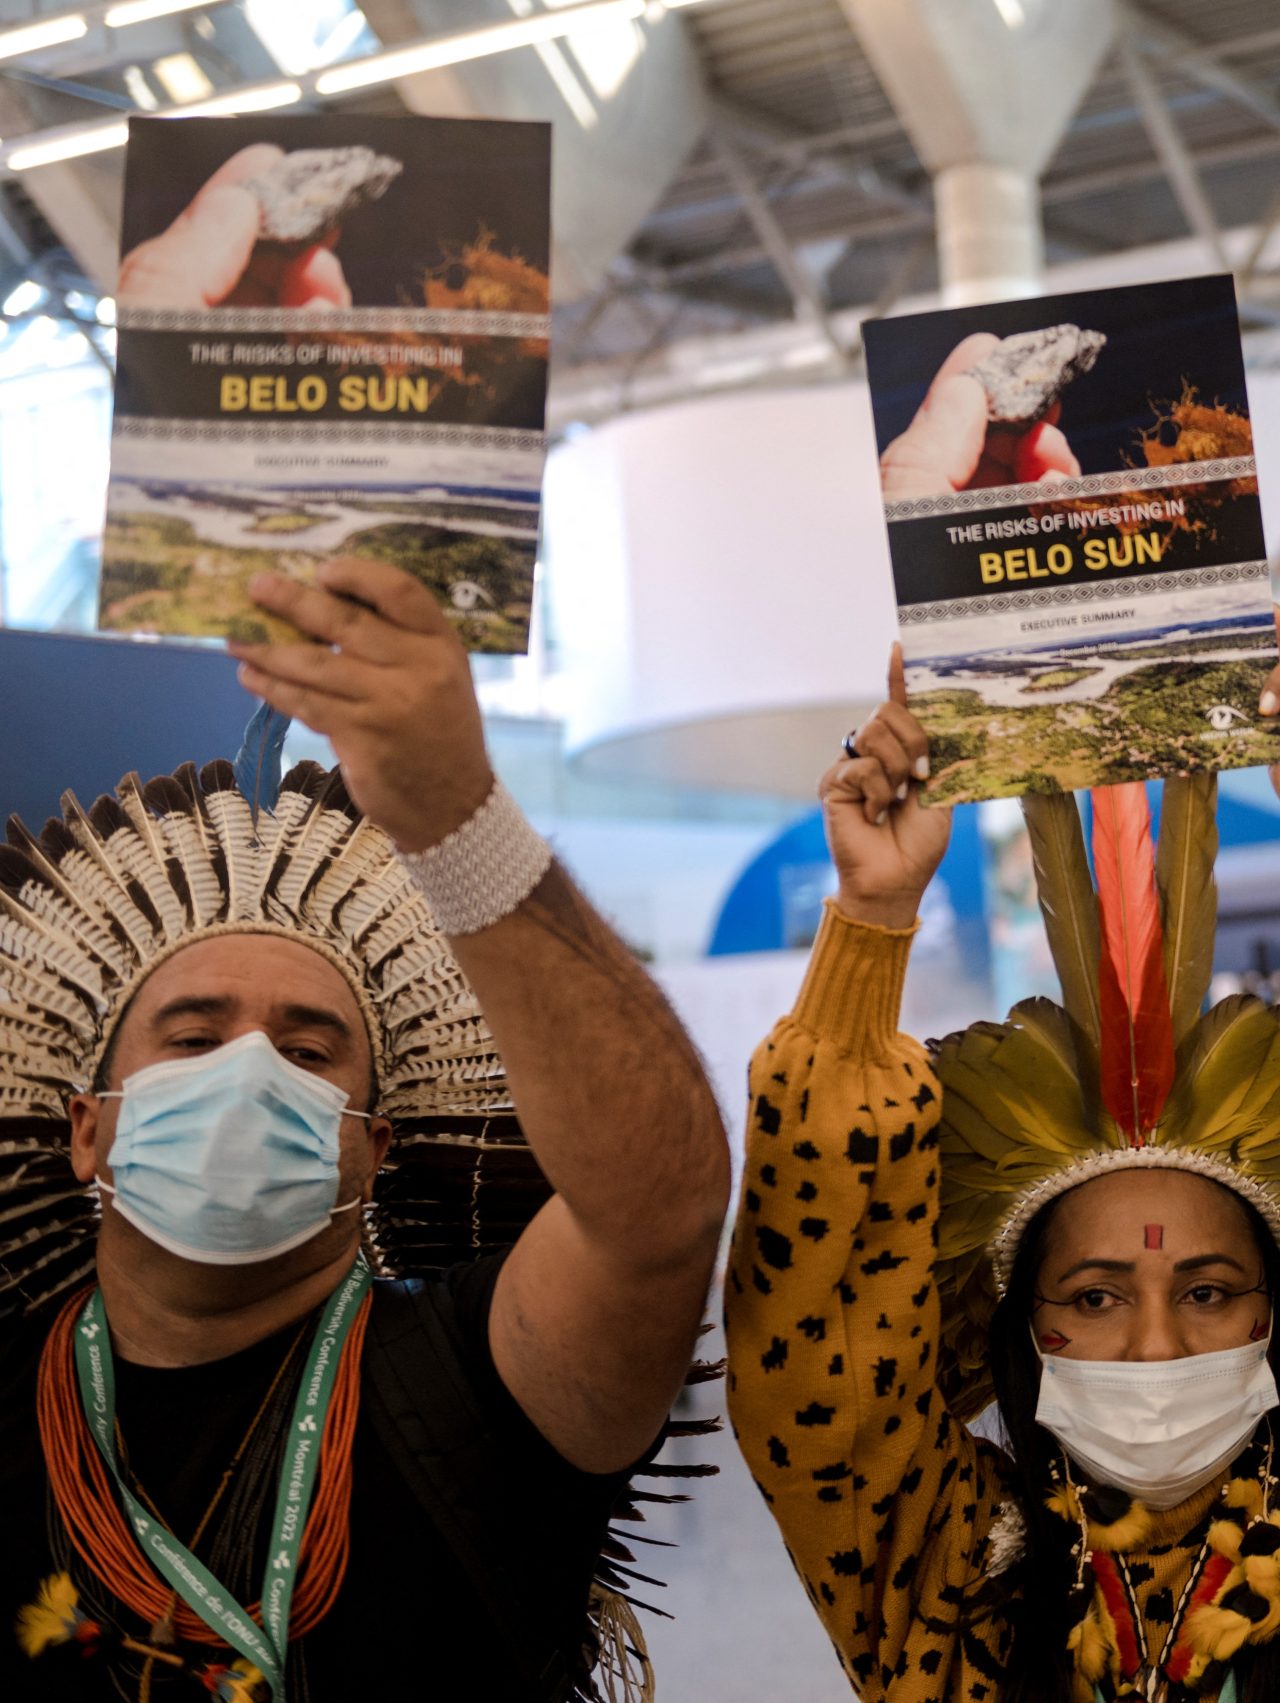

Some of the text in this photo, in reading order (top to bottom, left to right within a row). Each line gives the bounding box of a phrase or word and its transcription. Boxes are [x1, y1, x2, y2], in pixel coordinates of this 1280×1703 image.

[189, 343, 463, 367] THE RISKS OF INVESTING IN
[219, 375, 429, 413] BELO SUN
[946, 499, 1185, 544] THE RISKS OF INVESTING IN
[978, 532, 1163, 585] BELO SUN
[1020, 608, 1136, 632] EXECUTIVE SUMMARY
[325, 1276, 361, 1335] Biodiversity
[88, 1344, 107, 1412] Conference
[307, 1336, 337, 1406] Conference
[281, 1438, 312, 1542] Montréal 2022
[150, 1534, 210, 1605] Conférence
[204, 1592, 223, 1616] de
